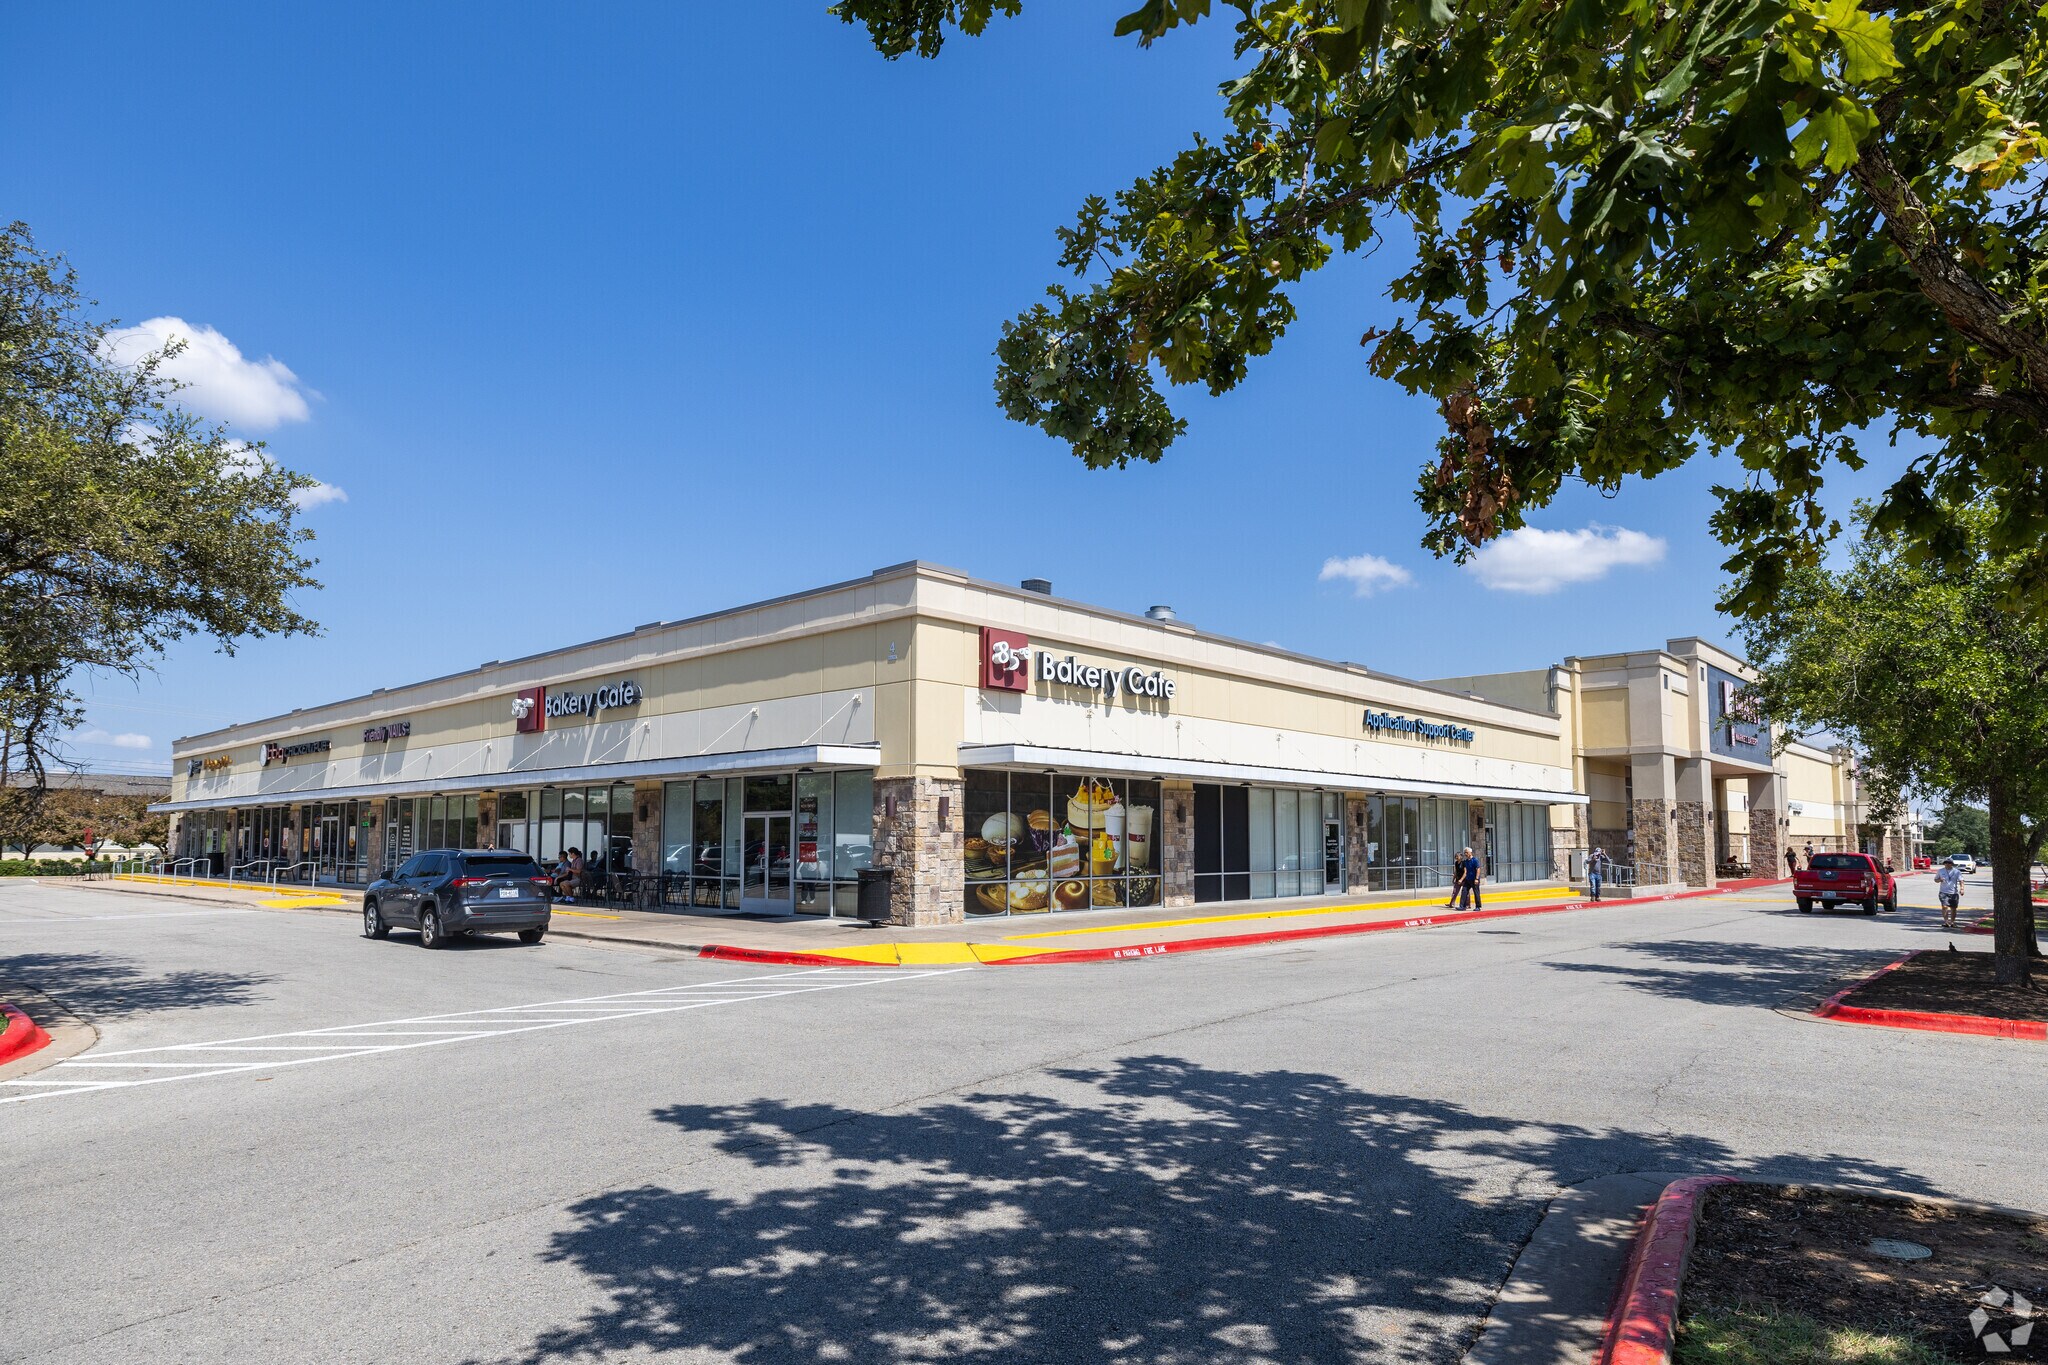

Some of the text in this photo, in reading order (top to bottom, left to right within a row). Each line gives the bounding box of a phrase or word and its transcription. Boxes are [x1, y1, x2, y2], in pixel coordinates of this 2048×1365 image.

[1037, 651, 1121, 699] Bakery
[1123, 667, 1177, 700] Cafe
[545, 692, 596, 718] Bakery
[364, 722, 410, 743] Friendly NAILS
[1365, 708, 1475, 742] Application Support Center
